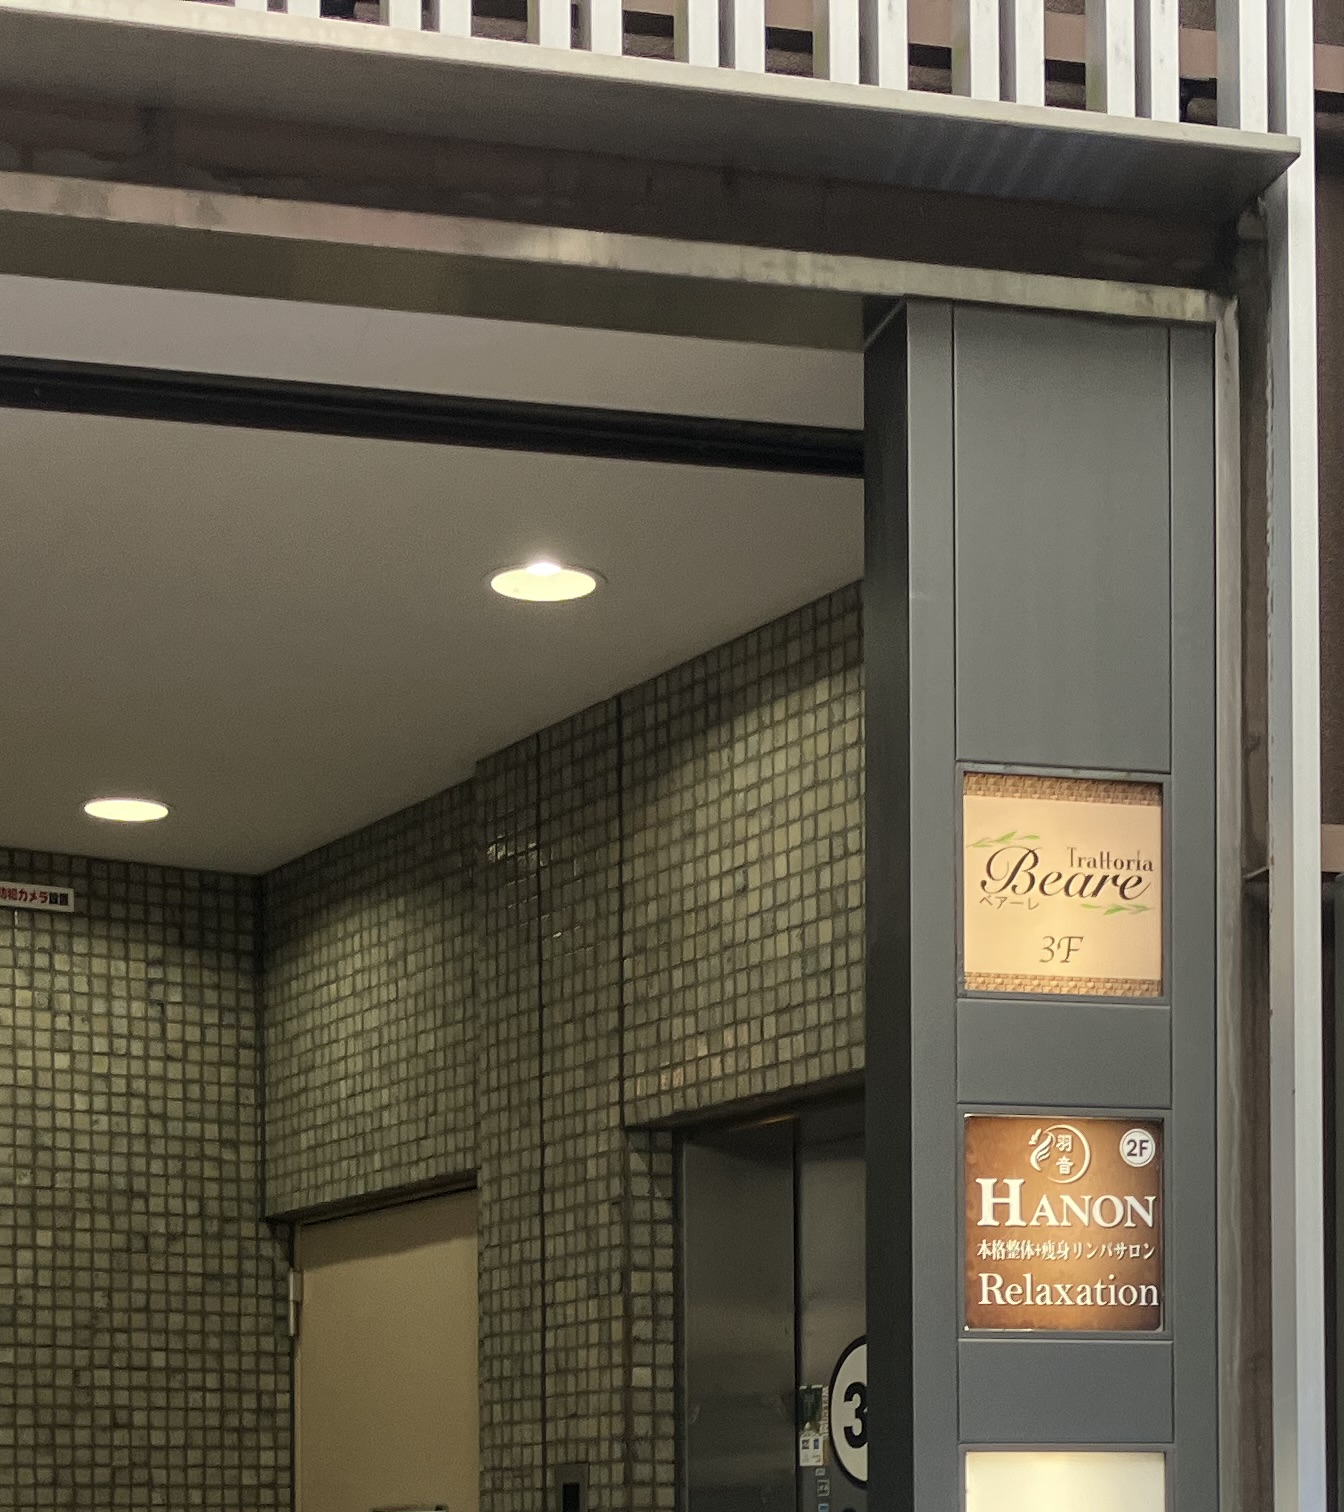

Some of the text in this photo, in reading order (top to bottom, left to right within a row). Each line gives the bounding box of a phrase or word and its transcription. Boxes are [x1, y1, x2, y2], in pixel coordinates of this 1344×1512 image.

[980, 846, 1151, 900] Beare
[1066, 847, 1154, 871] Trattoria
[1039, 936, 1084, 963] 3F
[1056, 1134, 1074, 1175] 羽音
[1126, 1139, 1150, 1157] 2F
[976, 1178, 1156, 1228] HANON
[978, 1272, 1159, 1306] Relaxation
